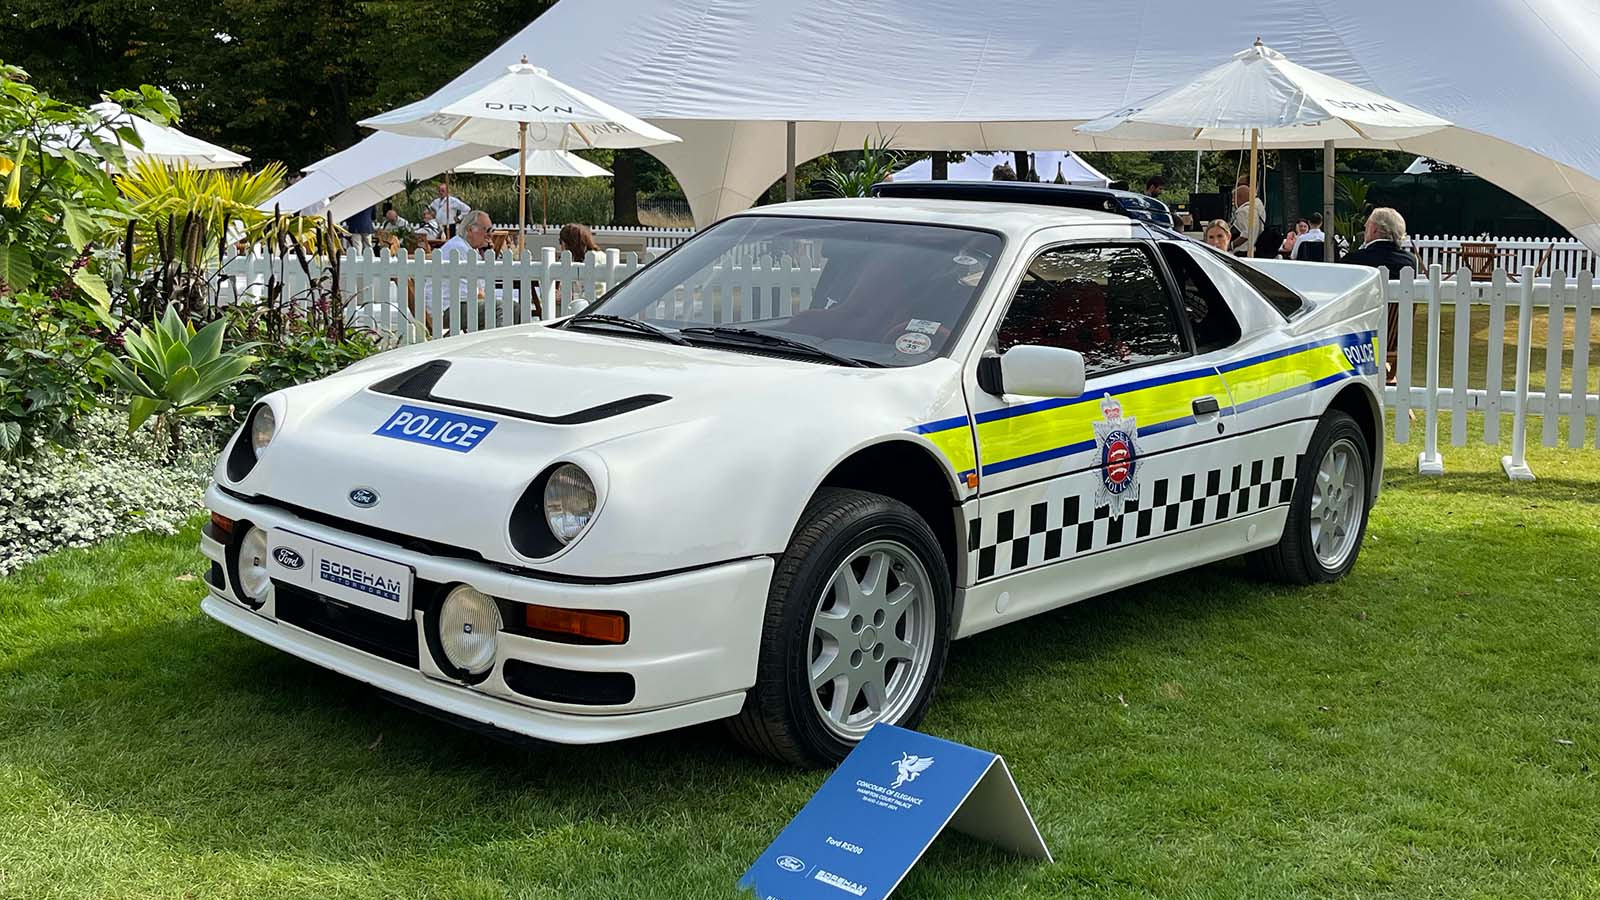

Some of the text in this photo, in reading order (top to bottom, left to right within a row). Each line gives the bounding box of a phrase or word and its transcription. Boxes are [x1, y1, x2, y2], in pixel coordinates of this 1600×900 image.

[485, 102, 573, 114] DRVN
[1325, 98, 1400, 113] DRVN
[1343, 343, 1375, 365] POLICE
[385, 411, 486, 447] POLICE
[278, 548, 300, 567] Ford
[320, 559, 400, 594] BOREHAM
[856, 780, 887, 794] CONCOURS
[893, 791, 924, 806] ELEGANCE
[825, 836, 864, 855] Ford RS200
